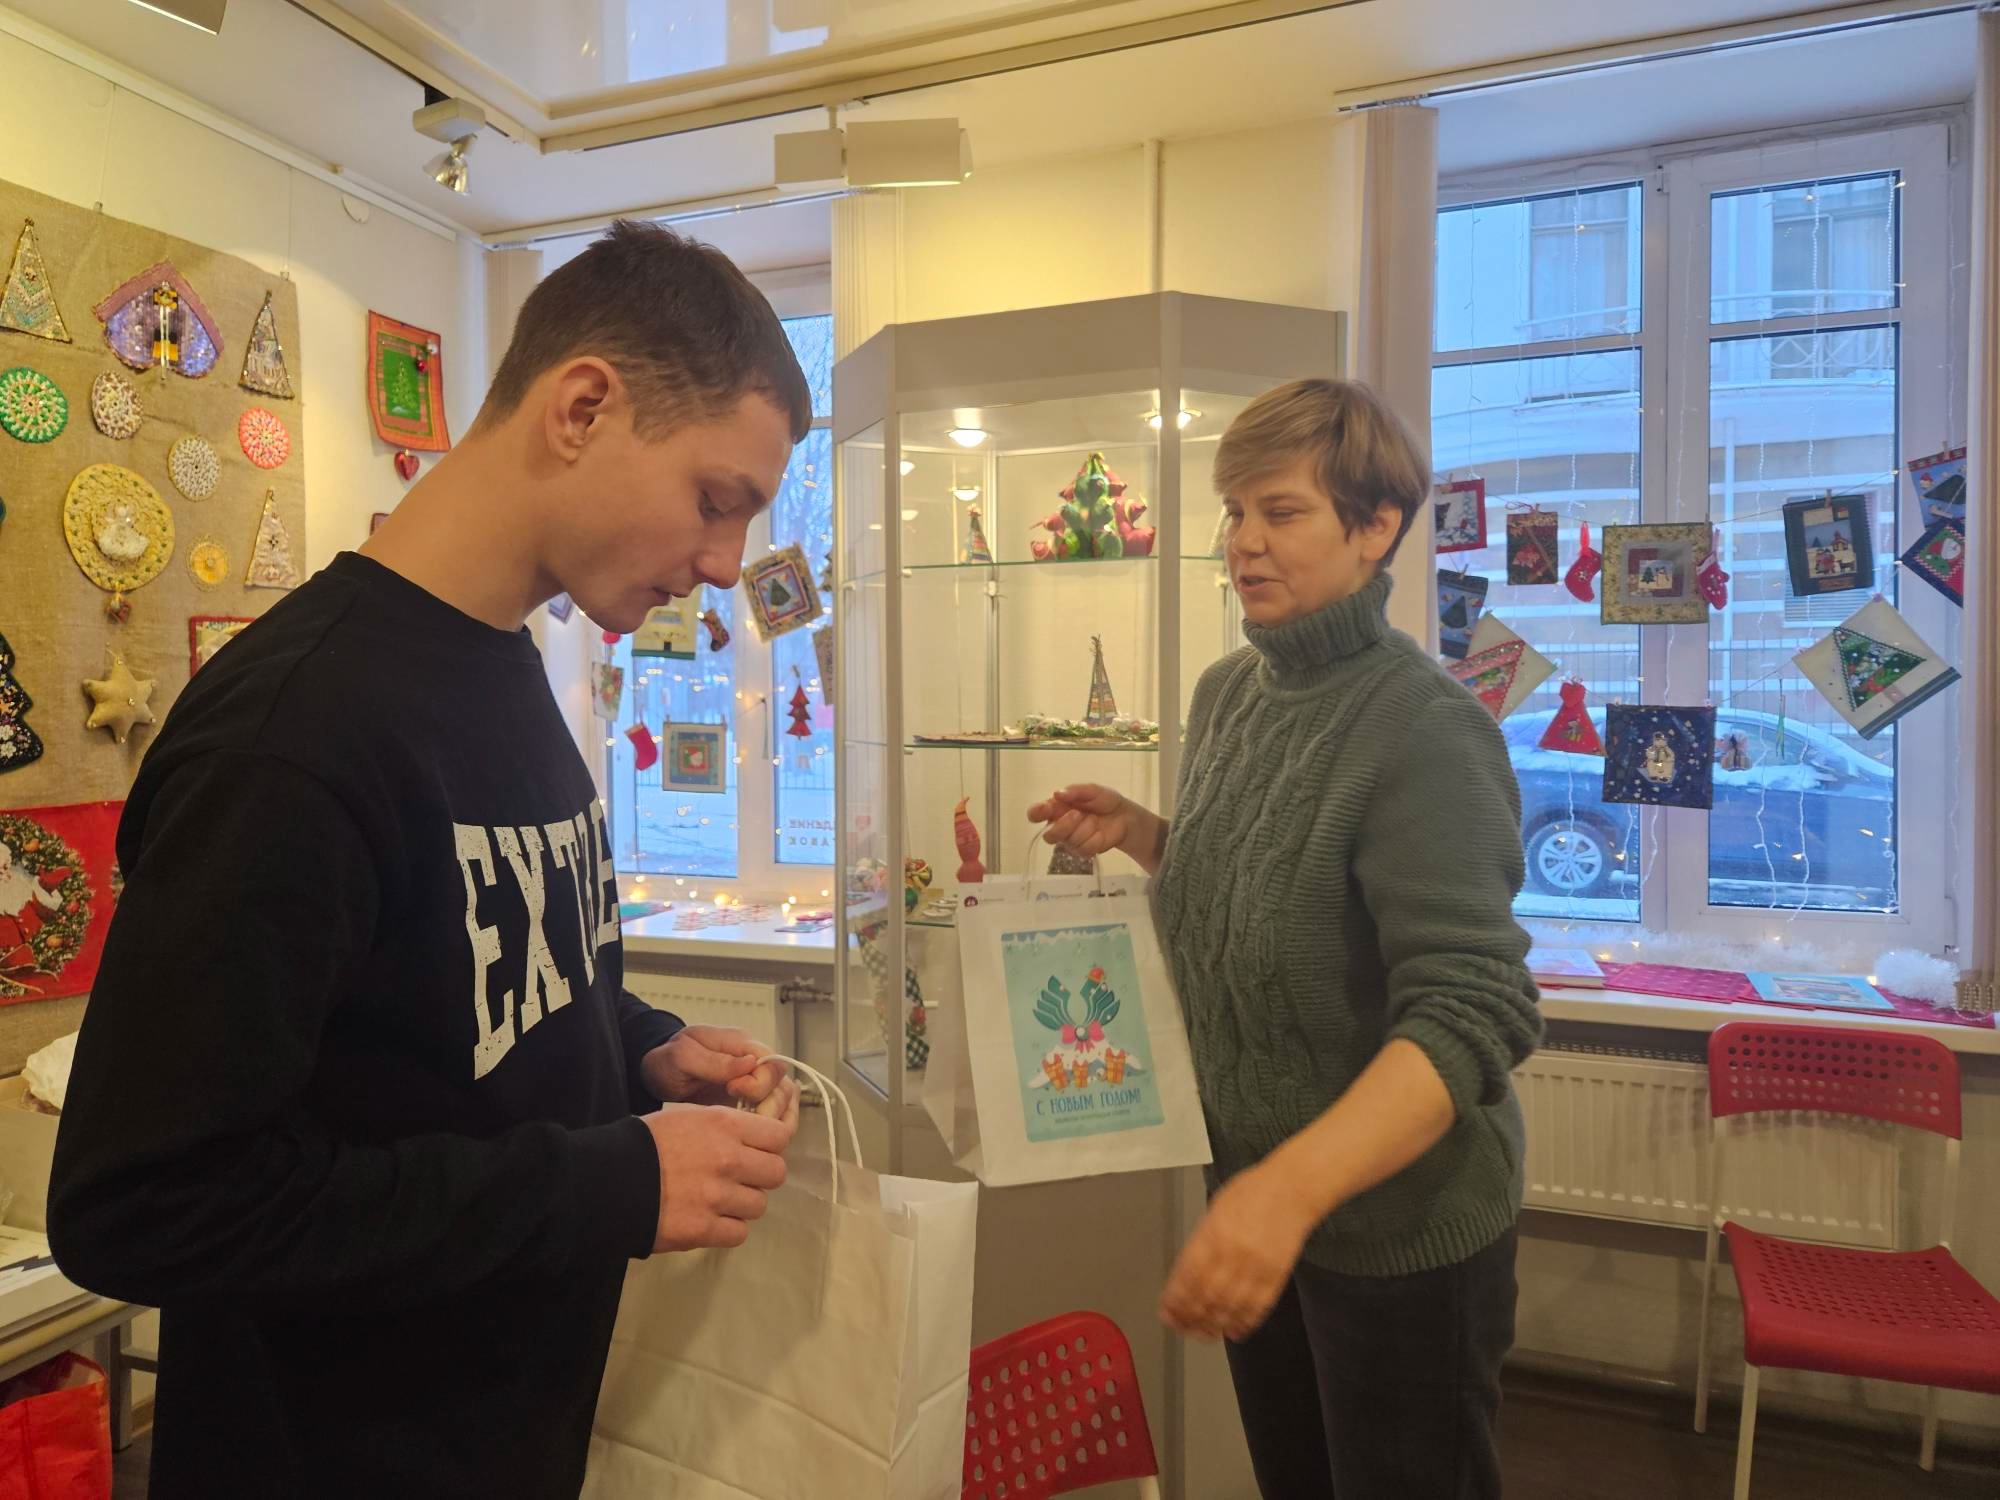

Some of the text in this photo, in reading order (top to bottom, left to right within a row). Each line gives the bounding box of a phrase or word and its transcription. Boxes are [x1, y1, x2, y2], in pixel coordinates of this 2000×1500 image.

[1036, 1100, 1045, 1116] С
[1050, 1093, 1094, 1114] НОВЫМ
[1100, 1087, 1142, 1107] ГОДОМ!
